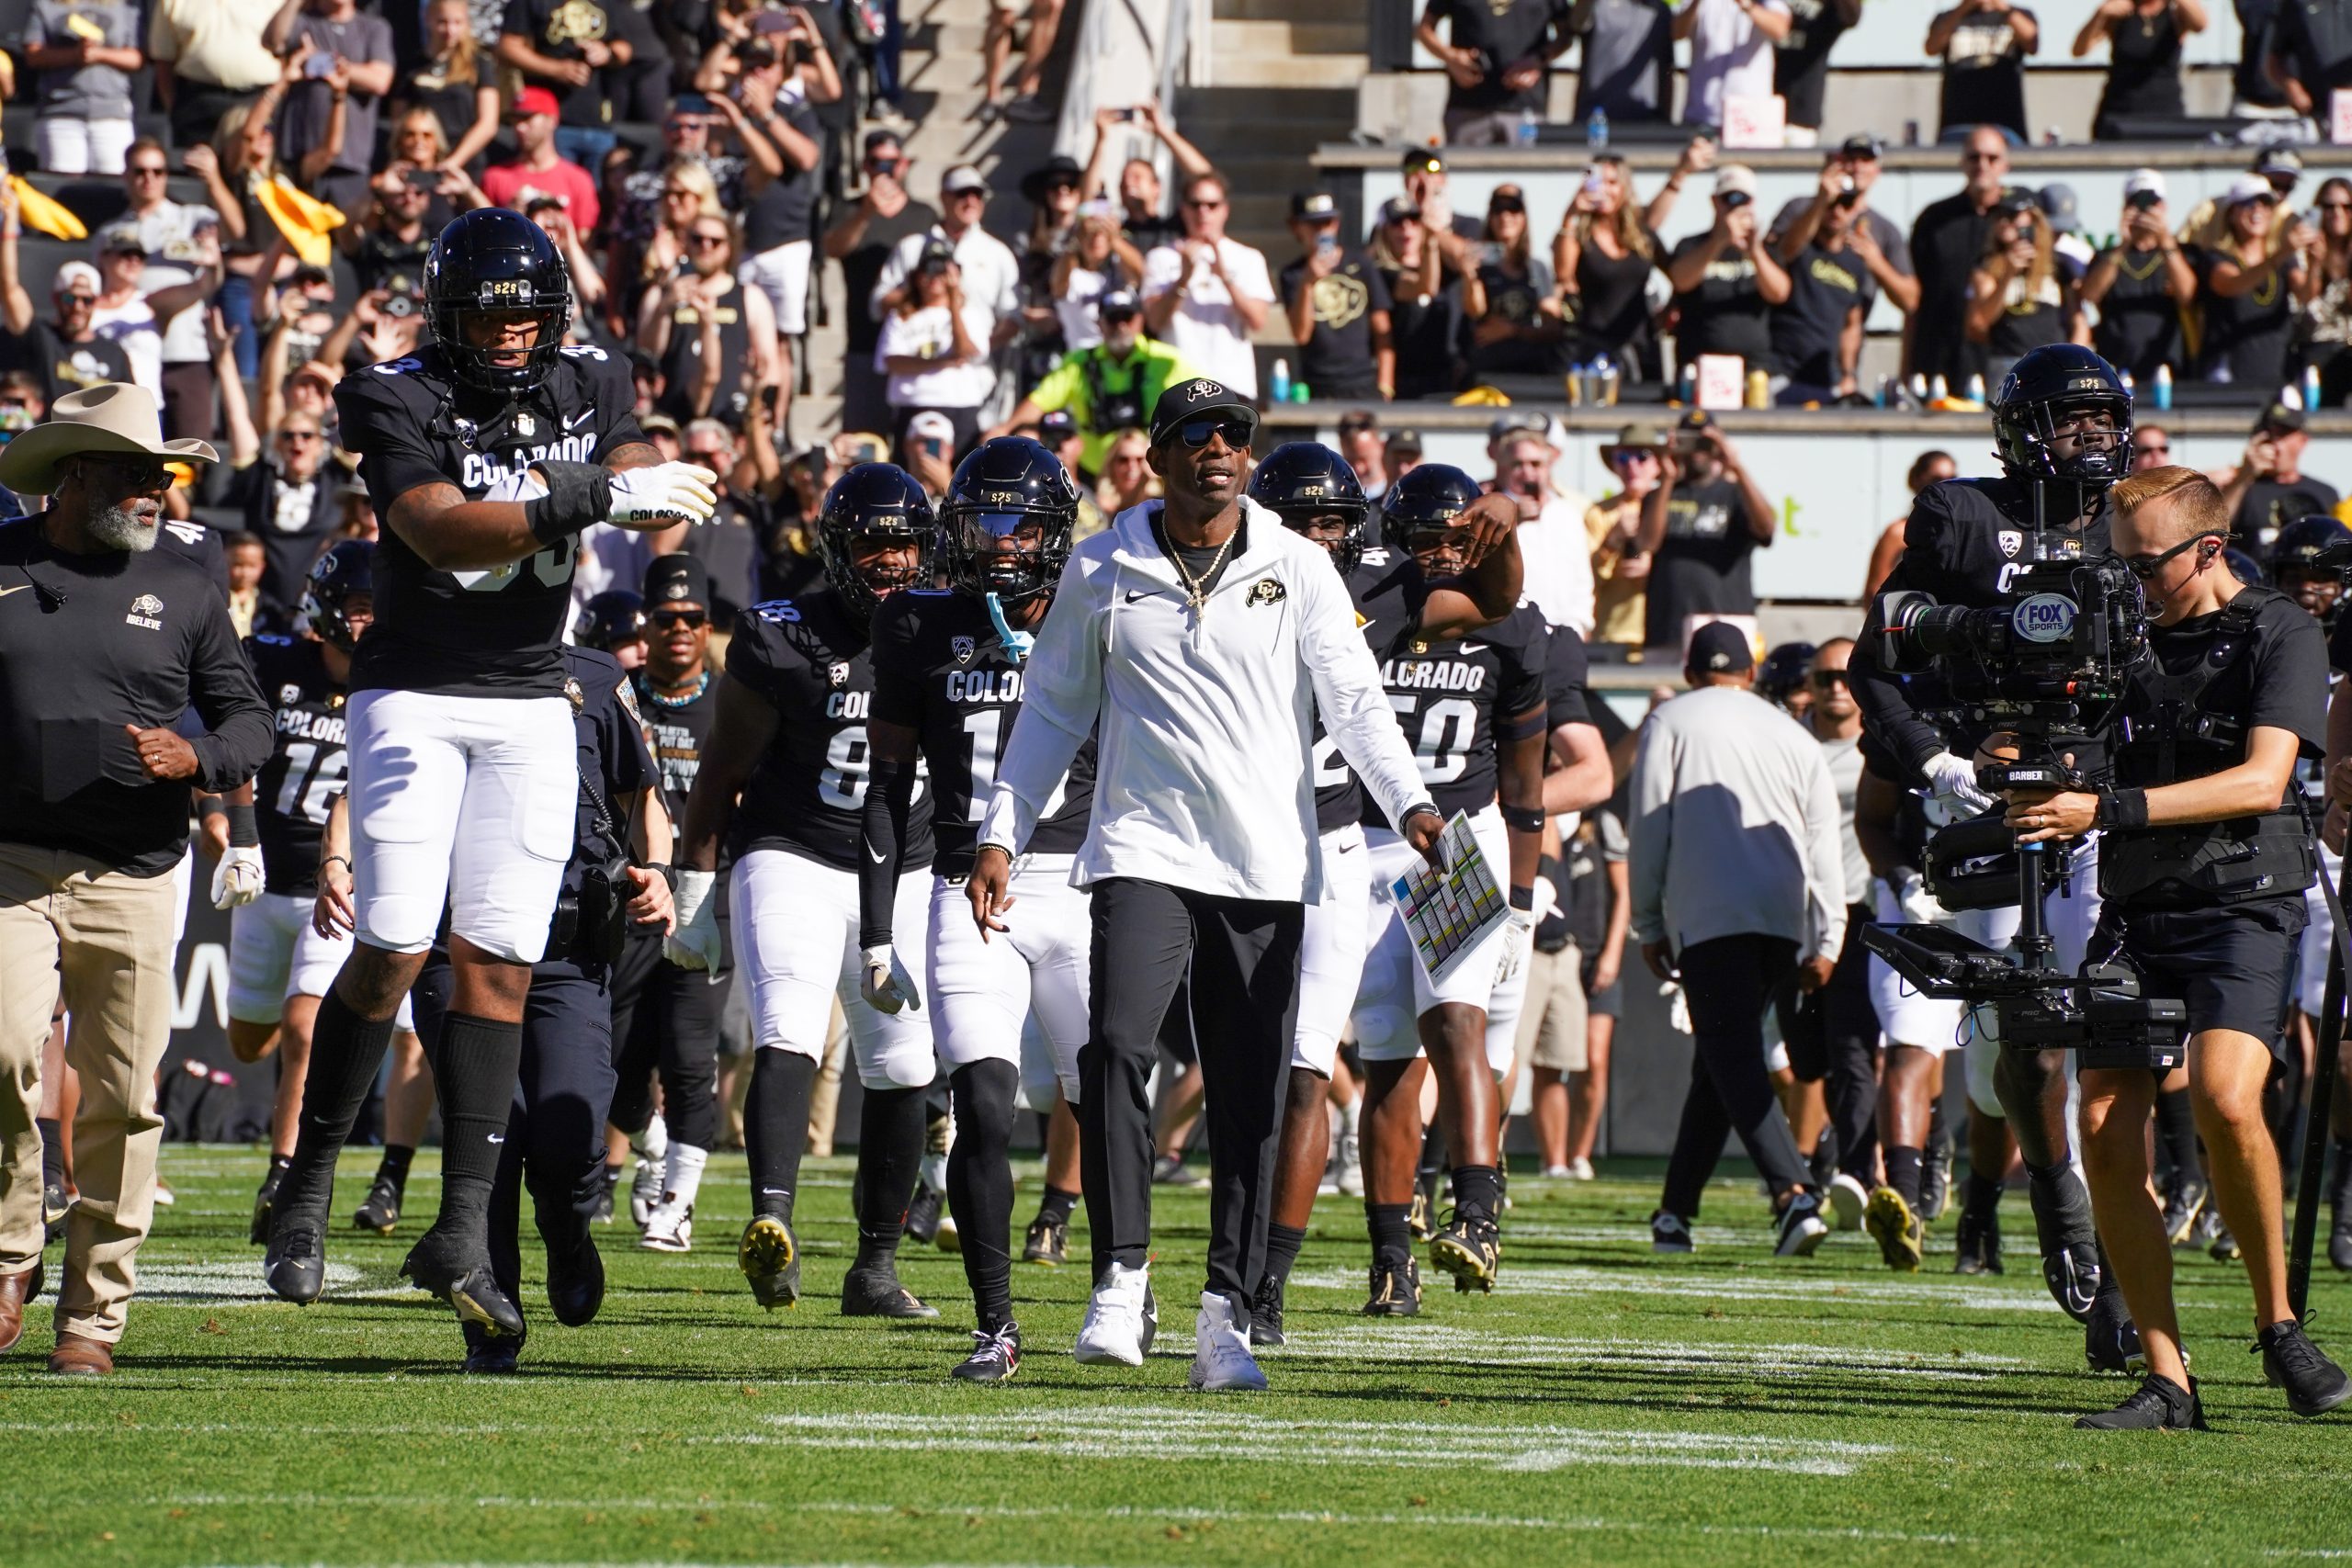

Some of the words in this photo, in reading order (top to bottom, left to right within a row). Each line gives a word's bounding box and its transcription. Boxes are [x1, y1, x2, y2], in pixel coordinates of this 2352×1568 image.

[2028, 604, 2063, 624] FOX
[2028, 622, 2064, 631] SPORTS
[2008, 771, 2043, 781] BARBER
